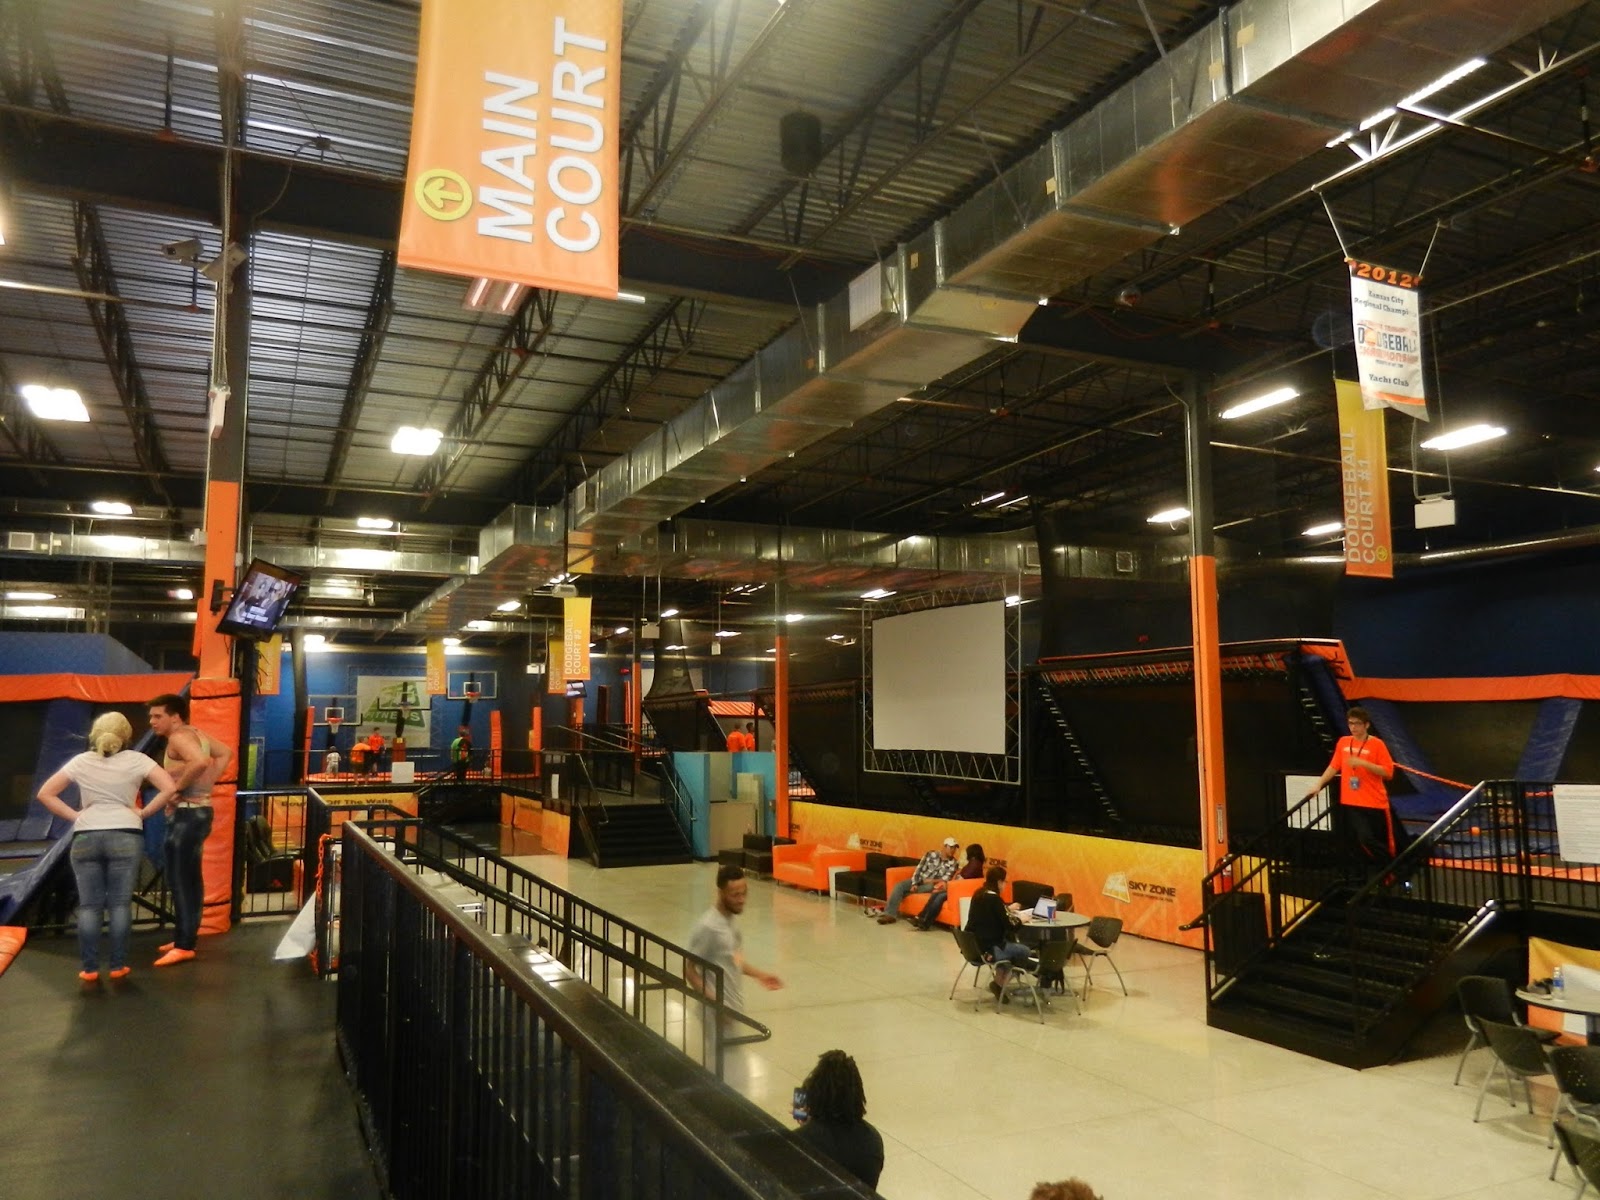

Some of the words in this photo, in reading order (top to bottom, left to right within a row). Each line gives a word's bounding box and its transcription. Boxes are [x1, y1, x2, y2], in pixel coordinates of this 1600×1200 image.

[477, 70, 540, 243] MAIN
[545, 16, 607, 252] COURT
[1356, 263, 1412, 288] 2012
[1341, 428, 1361, 563] DODGEBALL
[1359, 488, 1376, 564] COURT
[564, 617, 574, 675] DODGEBALL
[573, 643, 582, 675] COURT
[365, 711, 420, 722] FITNES
[1128, 880, 1148, 893] SKY
[1149, 883, 1176, 898] ZONE
